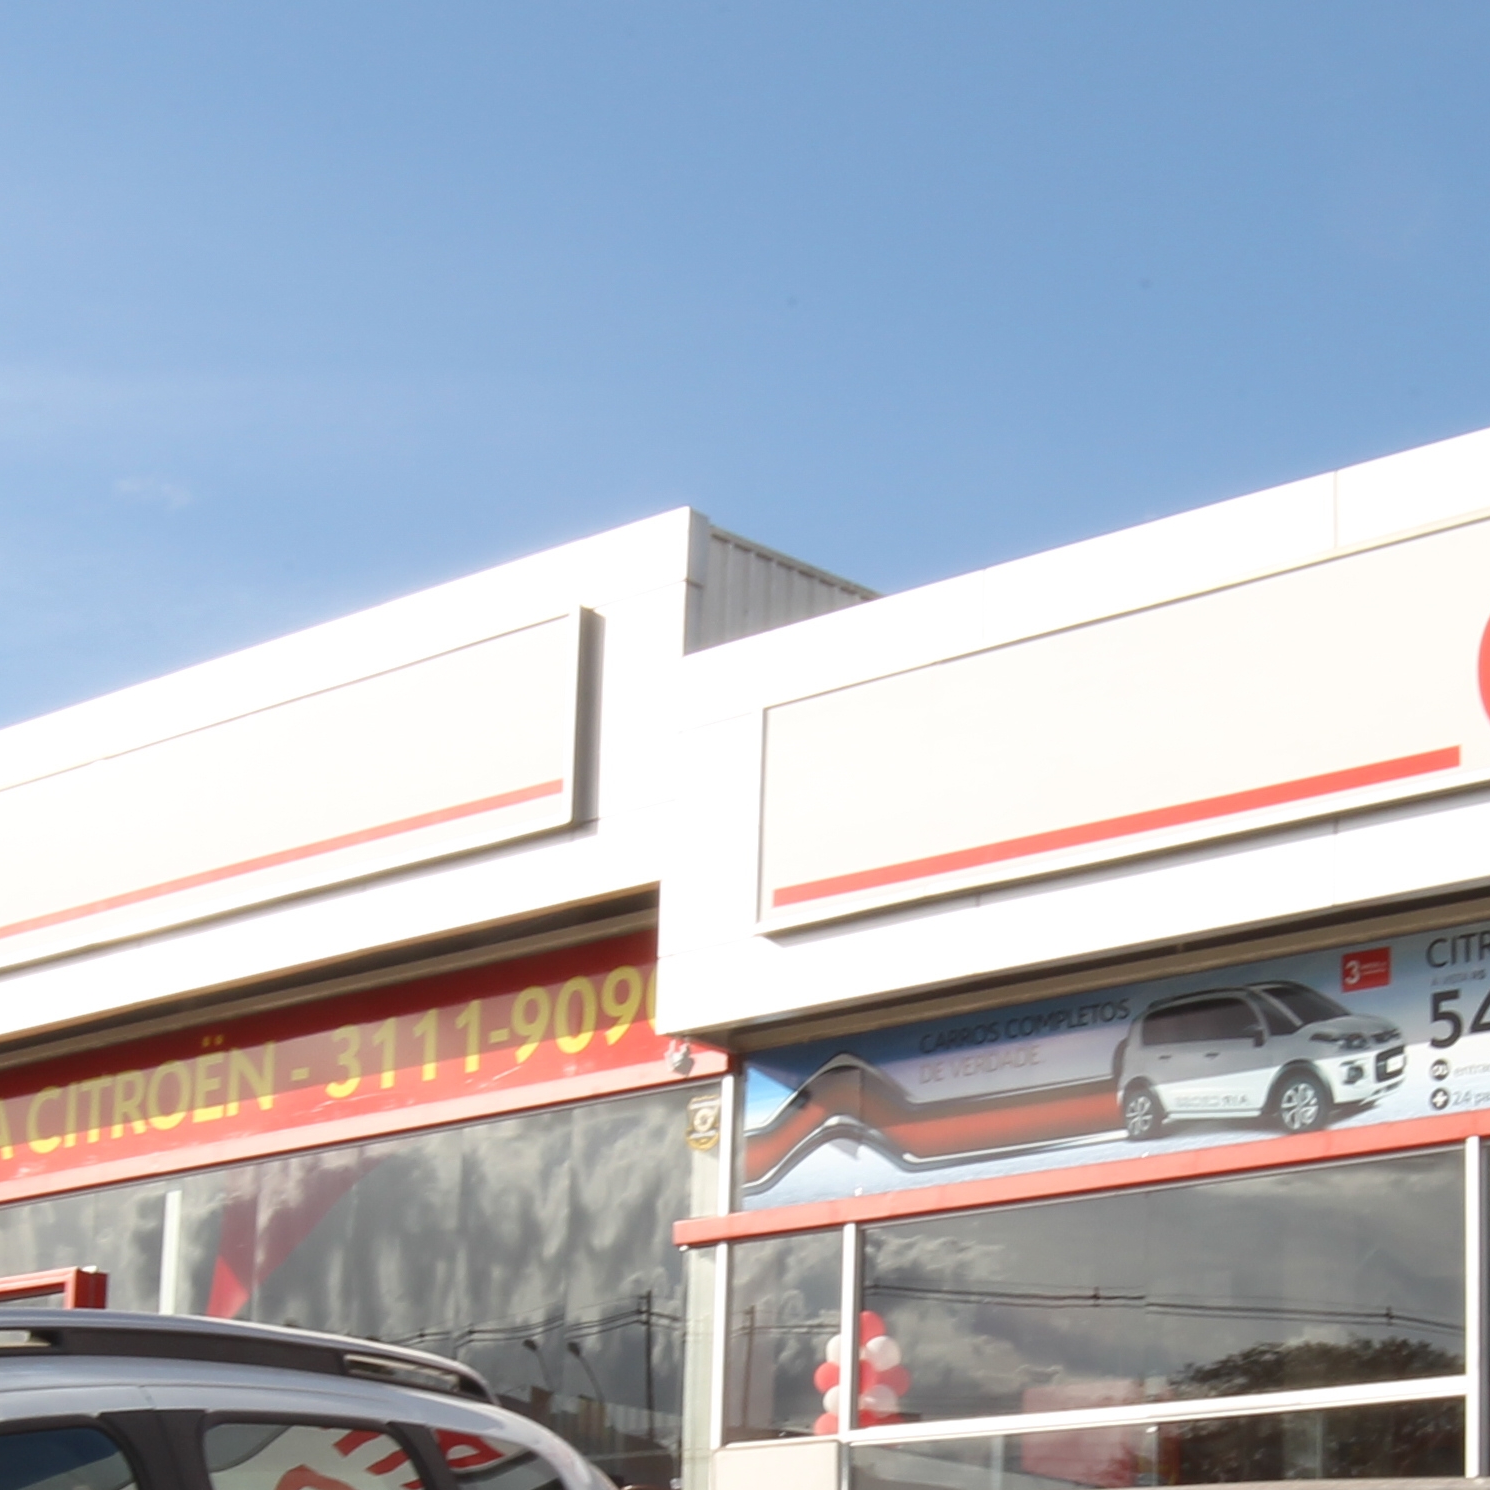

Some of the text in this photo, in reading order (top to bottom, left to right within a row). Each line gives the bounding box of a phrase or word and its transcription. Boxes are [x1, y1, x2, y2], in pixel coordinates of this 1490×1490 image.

[919, 997, 1133, 1054] CARROS COMPLETOS
[25, 1033, 276, 1155] CITROËN
[324, 964, 656, 1100] 3111-909
[918, 1060, 946, 1085] DE
[1451, 1090, 1473, 1107] 24
